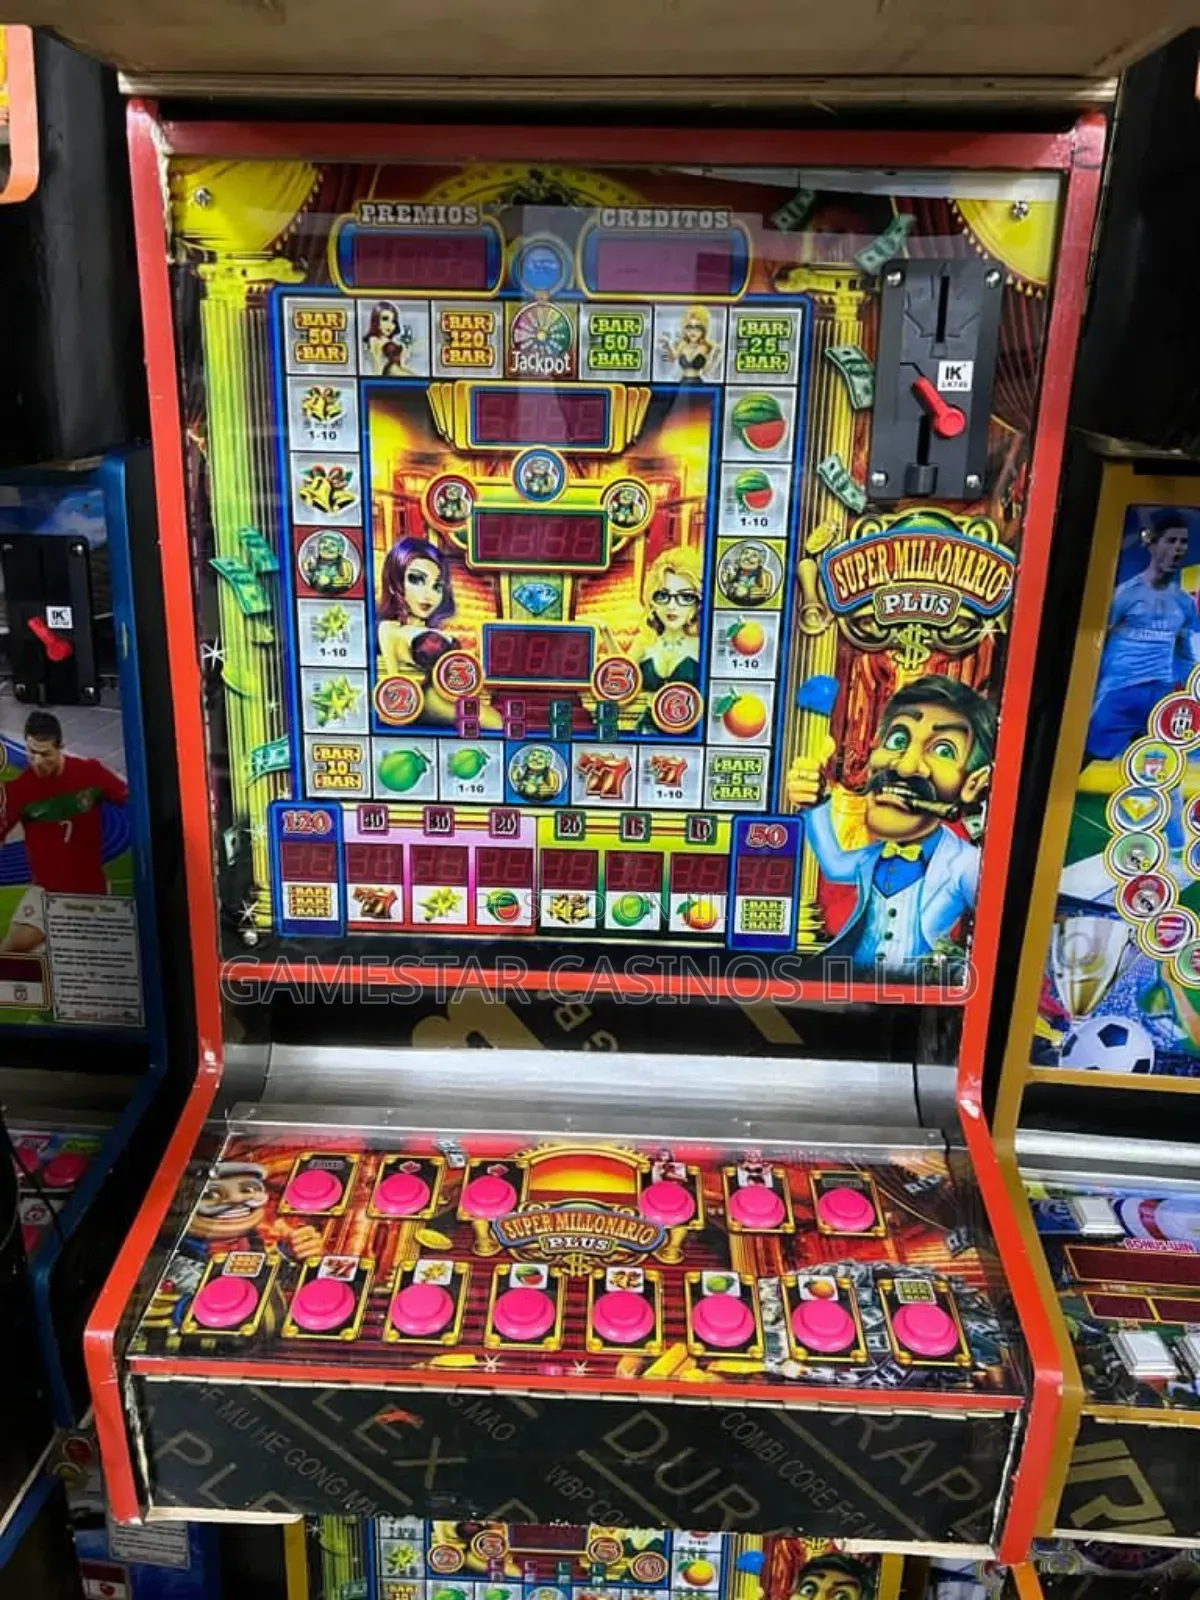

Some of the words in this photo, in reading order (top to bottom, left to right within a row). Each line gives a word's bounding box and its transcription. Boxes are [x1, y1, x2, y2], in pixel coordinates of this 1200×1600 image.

[361, 204, 478, 224] PREMIOS
[602, 210, 729, 229] CREDITOS
[301, 312, 340, 328] BAR
[448, 315, 488, 331] BAR
[597, 319, 637, 333] BAR
[745, 322, 785, 337] BAR
[309, 330, 333, 344] 50
[450, 331, 484, 347] 120
[604, 335, 629, 350] 50
[750, 338, 777, 353] 25
[302, 347, 341, 361] BAR
[448, 350, 488, 365] BAR
[596, 353, 635, 367] BAR
[511, 350, 572, 377] Jackpot
[744, 356, 783, 371] BAR
[308, 429, 338, 440] 1-10
[740, 517, 769, 528] 1-10
[833, 544, 890, 599] SUPER
[891, 540, 1008, 602] MILLONARIO
[882, 592, 952, 616] PLUS
[319, 647, 347, 658] 1-10
[731, 658, 760, 669] 1-10
[319, 747, 358, 760] BAR
[327, 761, 349, 775] 10
[719, 757, 757, 771] BAR
[320, 776, 358, 789] BAR
[730, 774, 744, 786] 5
[458, 784, 485, 795] 1-10
[656, 789, 683, 800] 1-10
[718, 786, 757, 800] BAR
[283, 809, 333, 835] 120
[746, 823, 789, 850] 50
[295, 886, 329, 897] BAR
[749, 900, 780, 909] BAR
[295, 907, 329, 917] BAR
[749, 911, 780, 920] BAR
[749, 920, 780, 931] BAR
[503, 1215, 552, 1240] SUPER
[557, 1211, 656, 1244] MILLONARIO
[547, 1235, 610, 1250] PLUS
